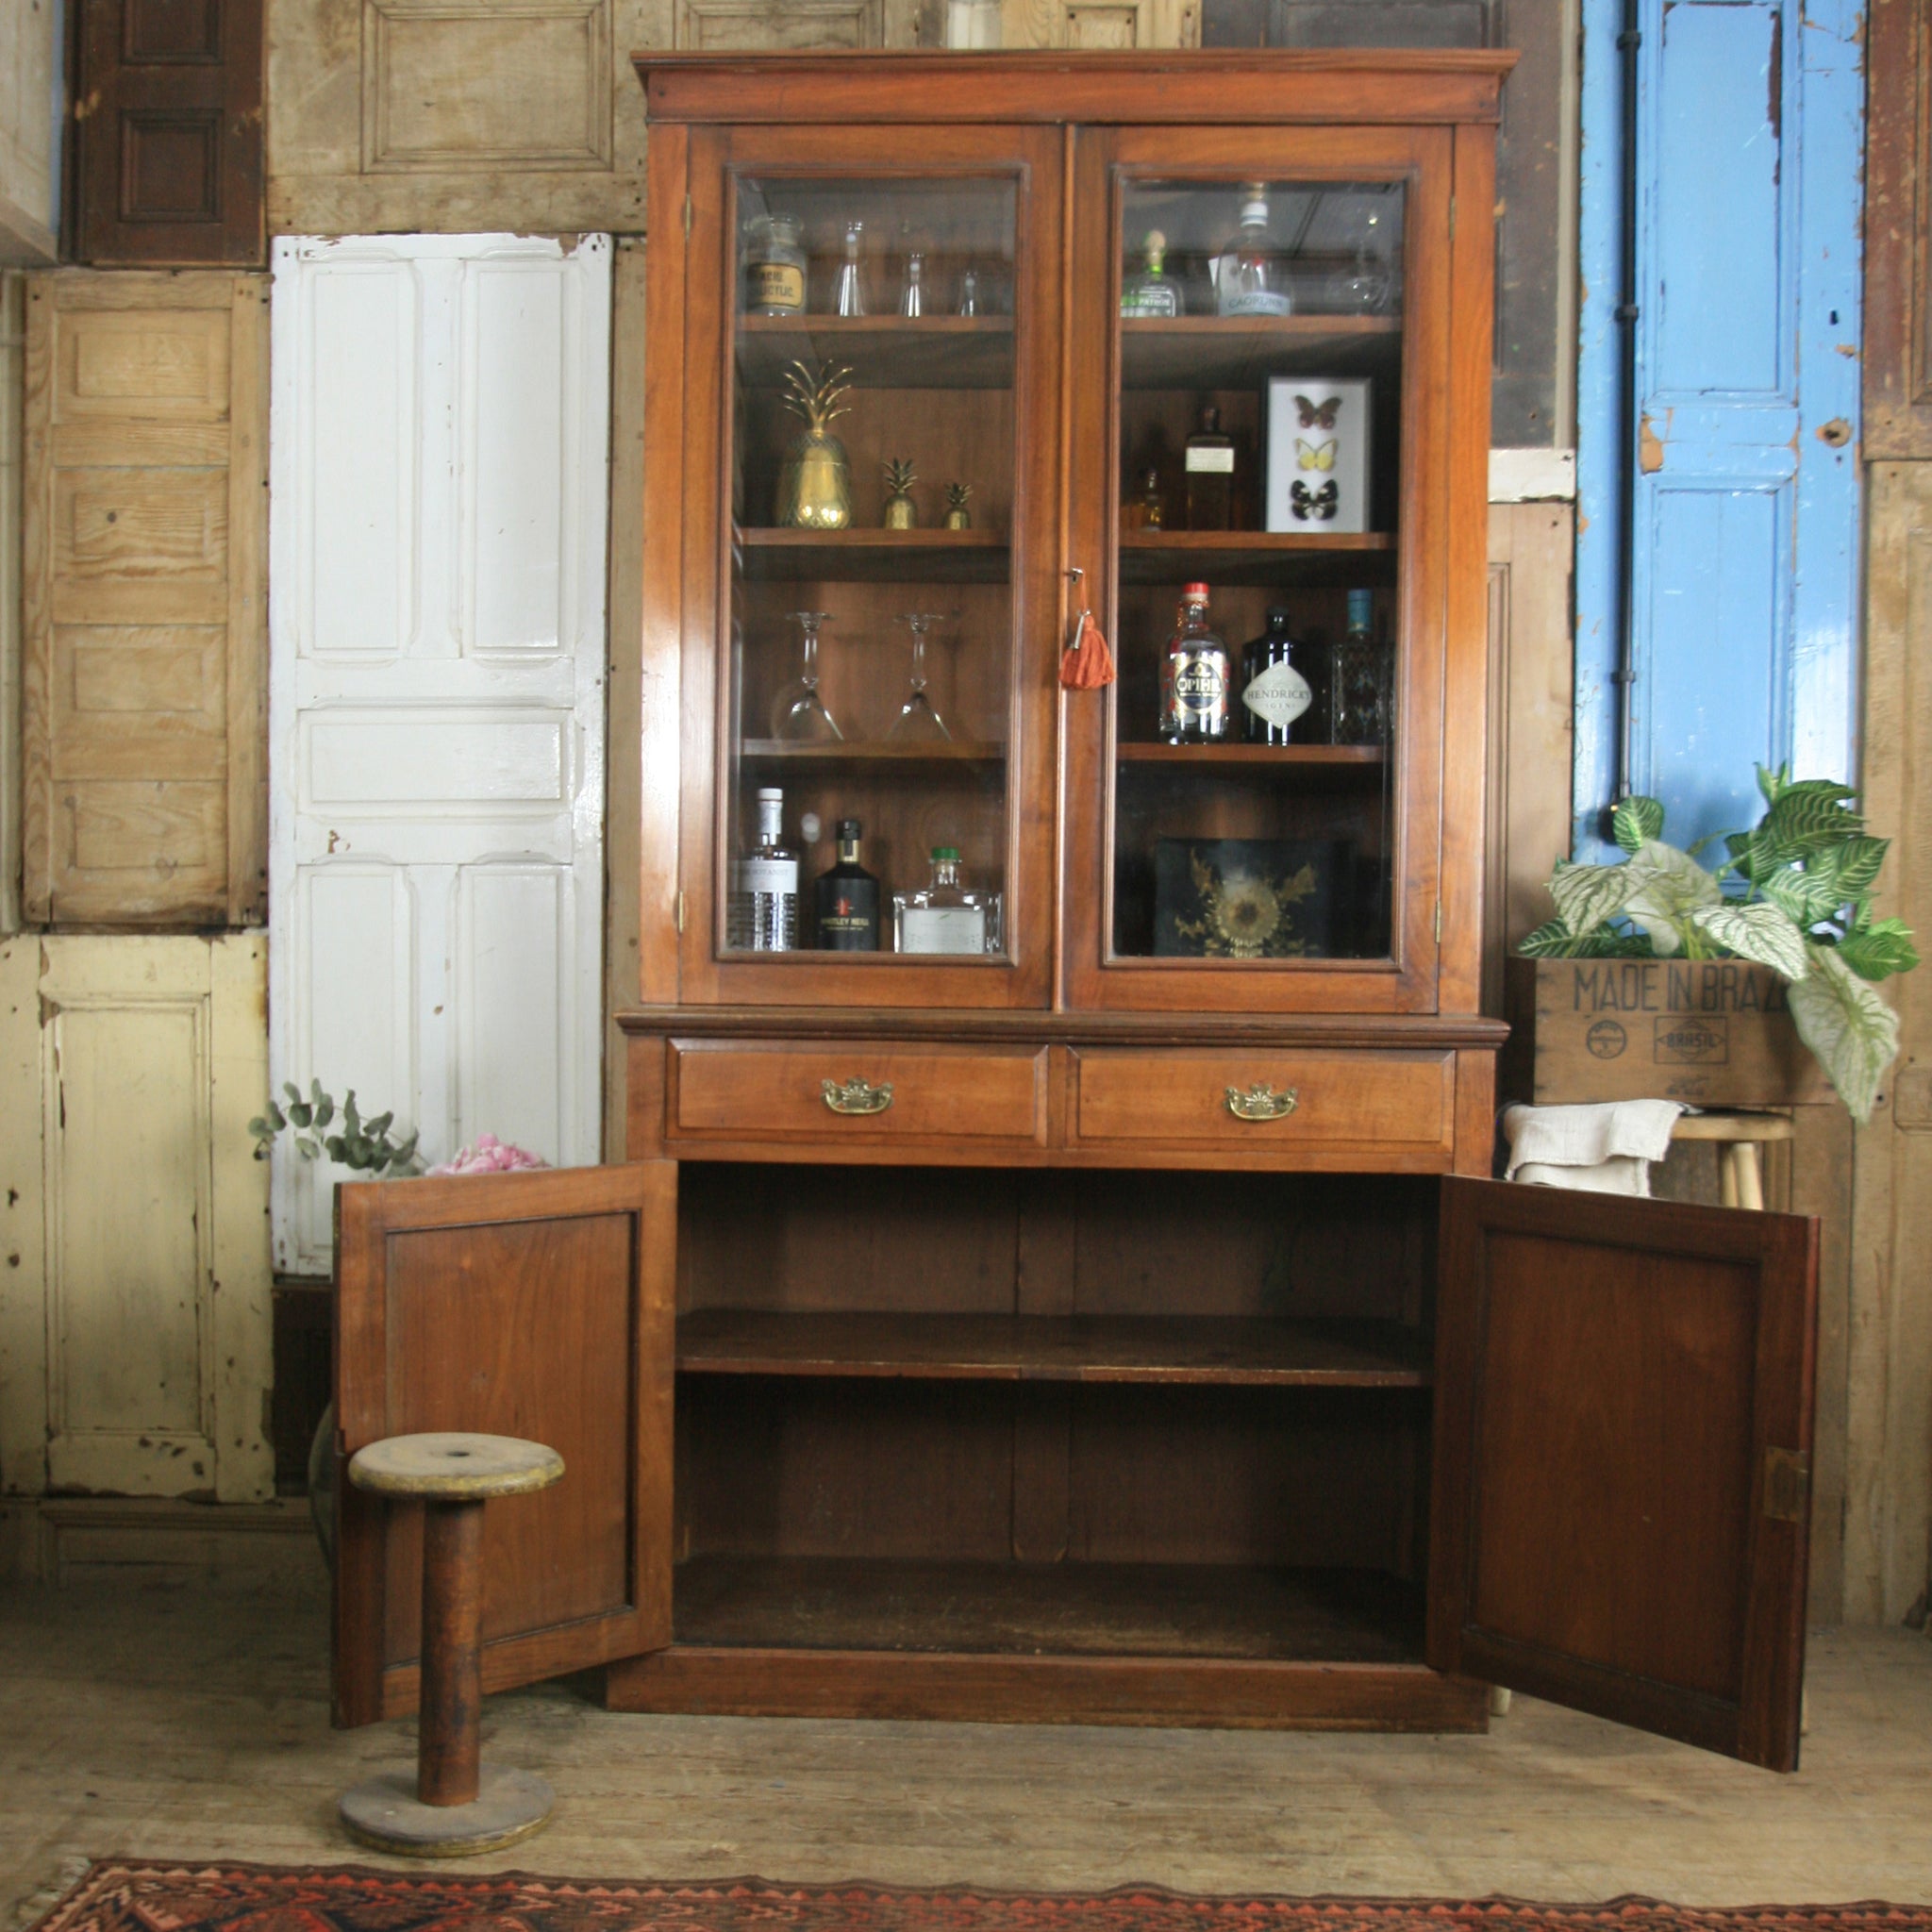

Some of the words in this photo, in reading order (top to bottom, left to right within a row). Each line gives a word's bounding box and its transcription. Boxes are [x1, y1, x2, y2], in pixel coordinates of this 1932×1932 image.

[1176, 676, 1222, 693] OPIHR
[1573, 963, 1659, 1012] MADE
[1667, 963, 1692, 1012] IN
[1666, 1032, 1718, 1049] BRASIL
